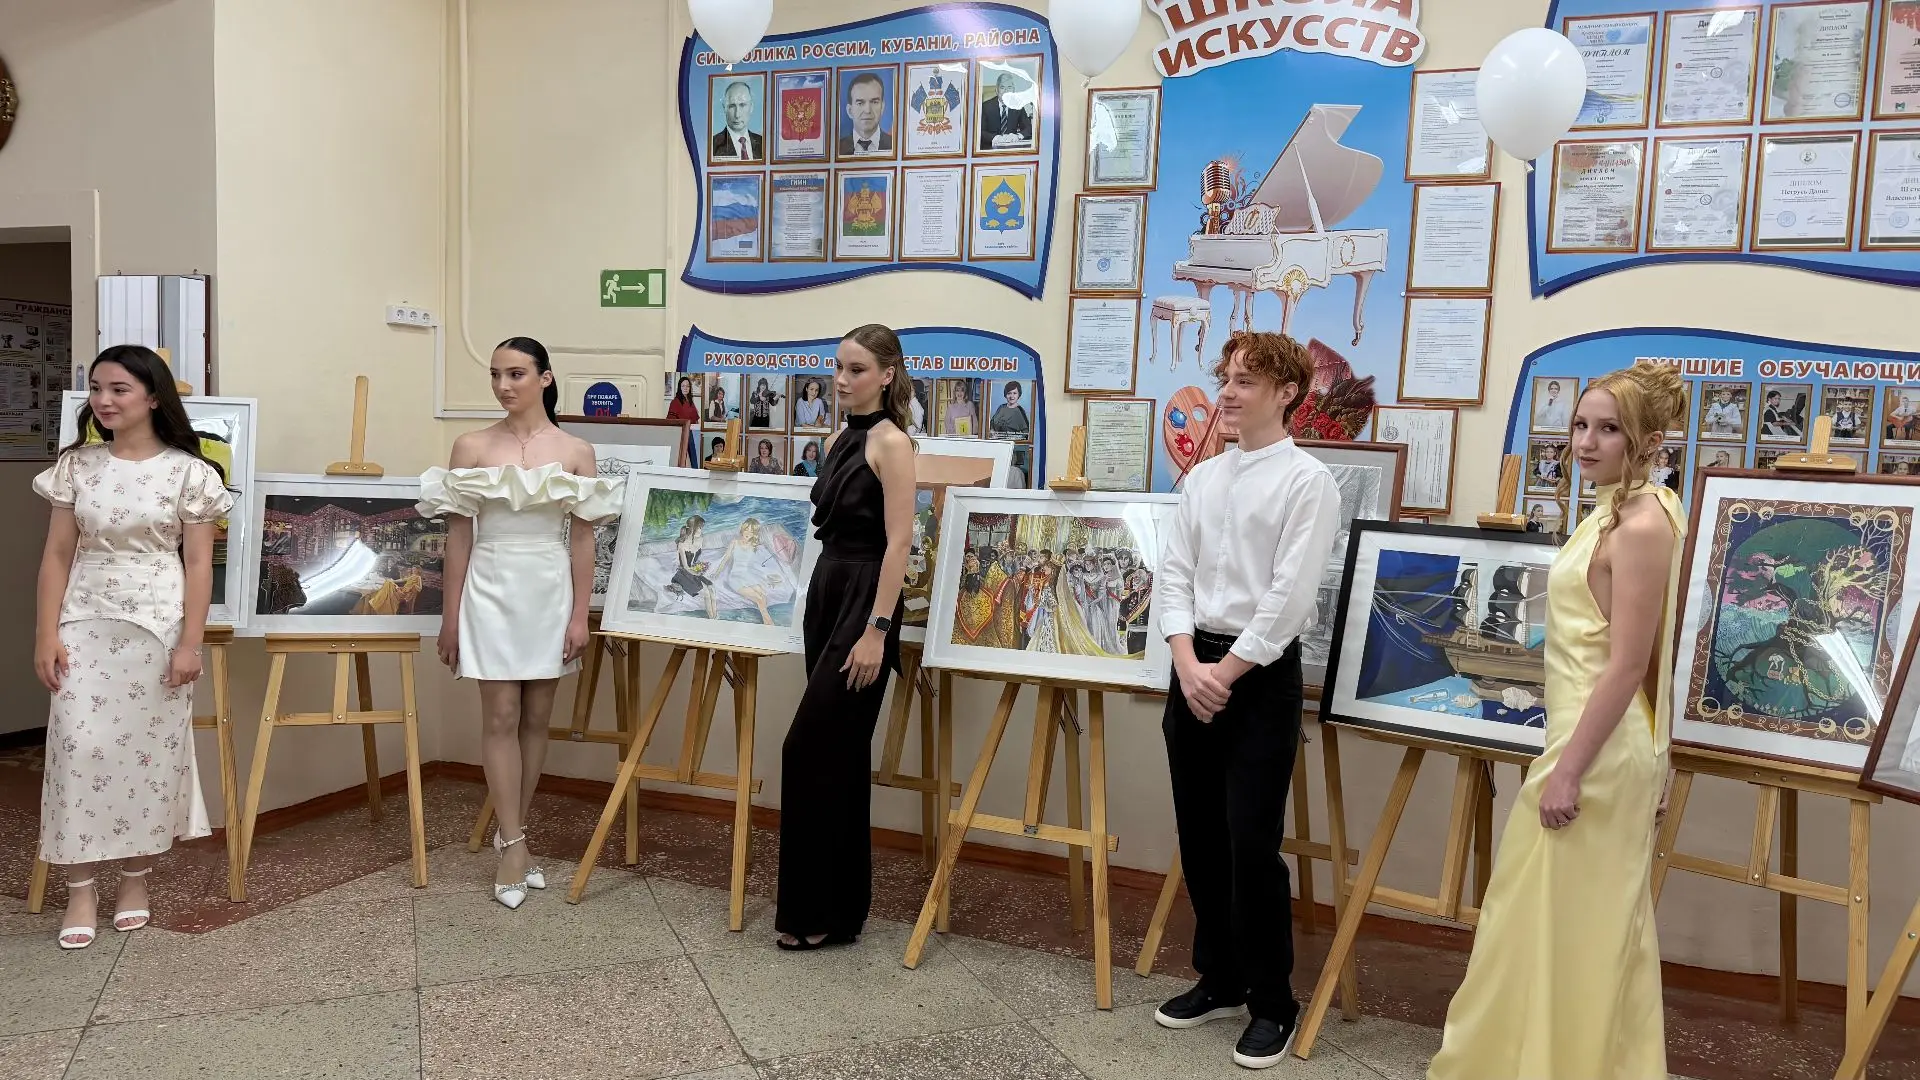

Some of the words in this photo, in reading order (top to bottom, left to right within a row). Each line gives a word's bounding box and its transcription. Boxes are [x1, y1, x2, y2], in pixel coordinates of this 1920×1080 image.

[696, 45, 797, 67] СИОЛИКА
[801, 40, 876, 59] РОССИИ,
[881, 35, 960, 51] КУБАНИ,
[964, 28, 1041, 48] РАЙОНА
[1157, 15, 1420, 77] ИСКУССТВ
[705, 353, 820, 369] РУКОВОДСТВО
[949, 356, 1019, 372] ШКОЛЫ
[1635, 357, 1743, 377] ЧШИЕ
